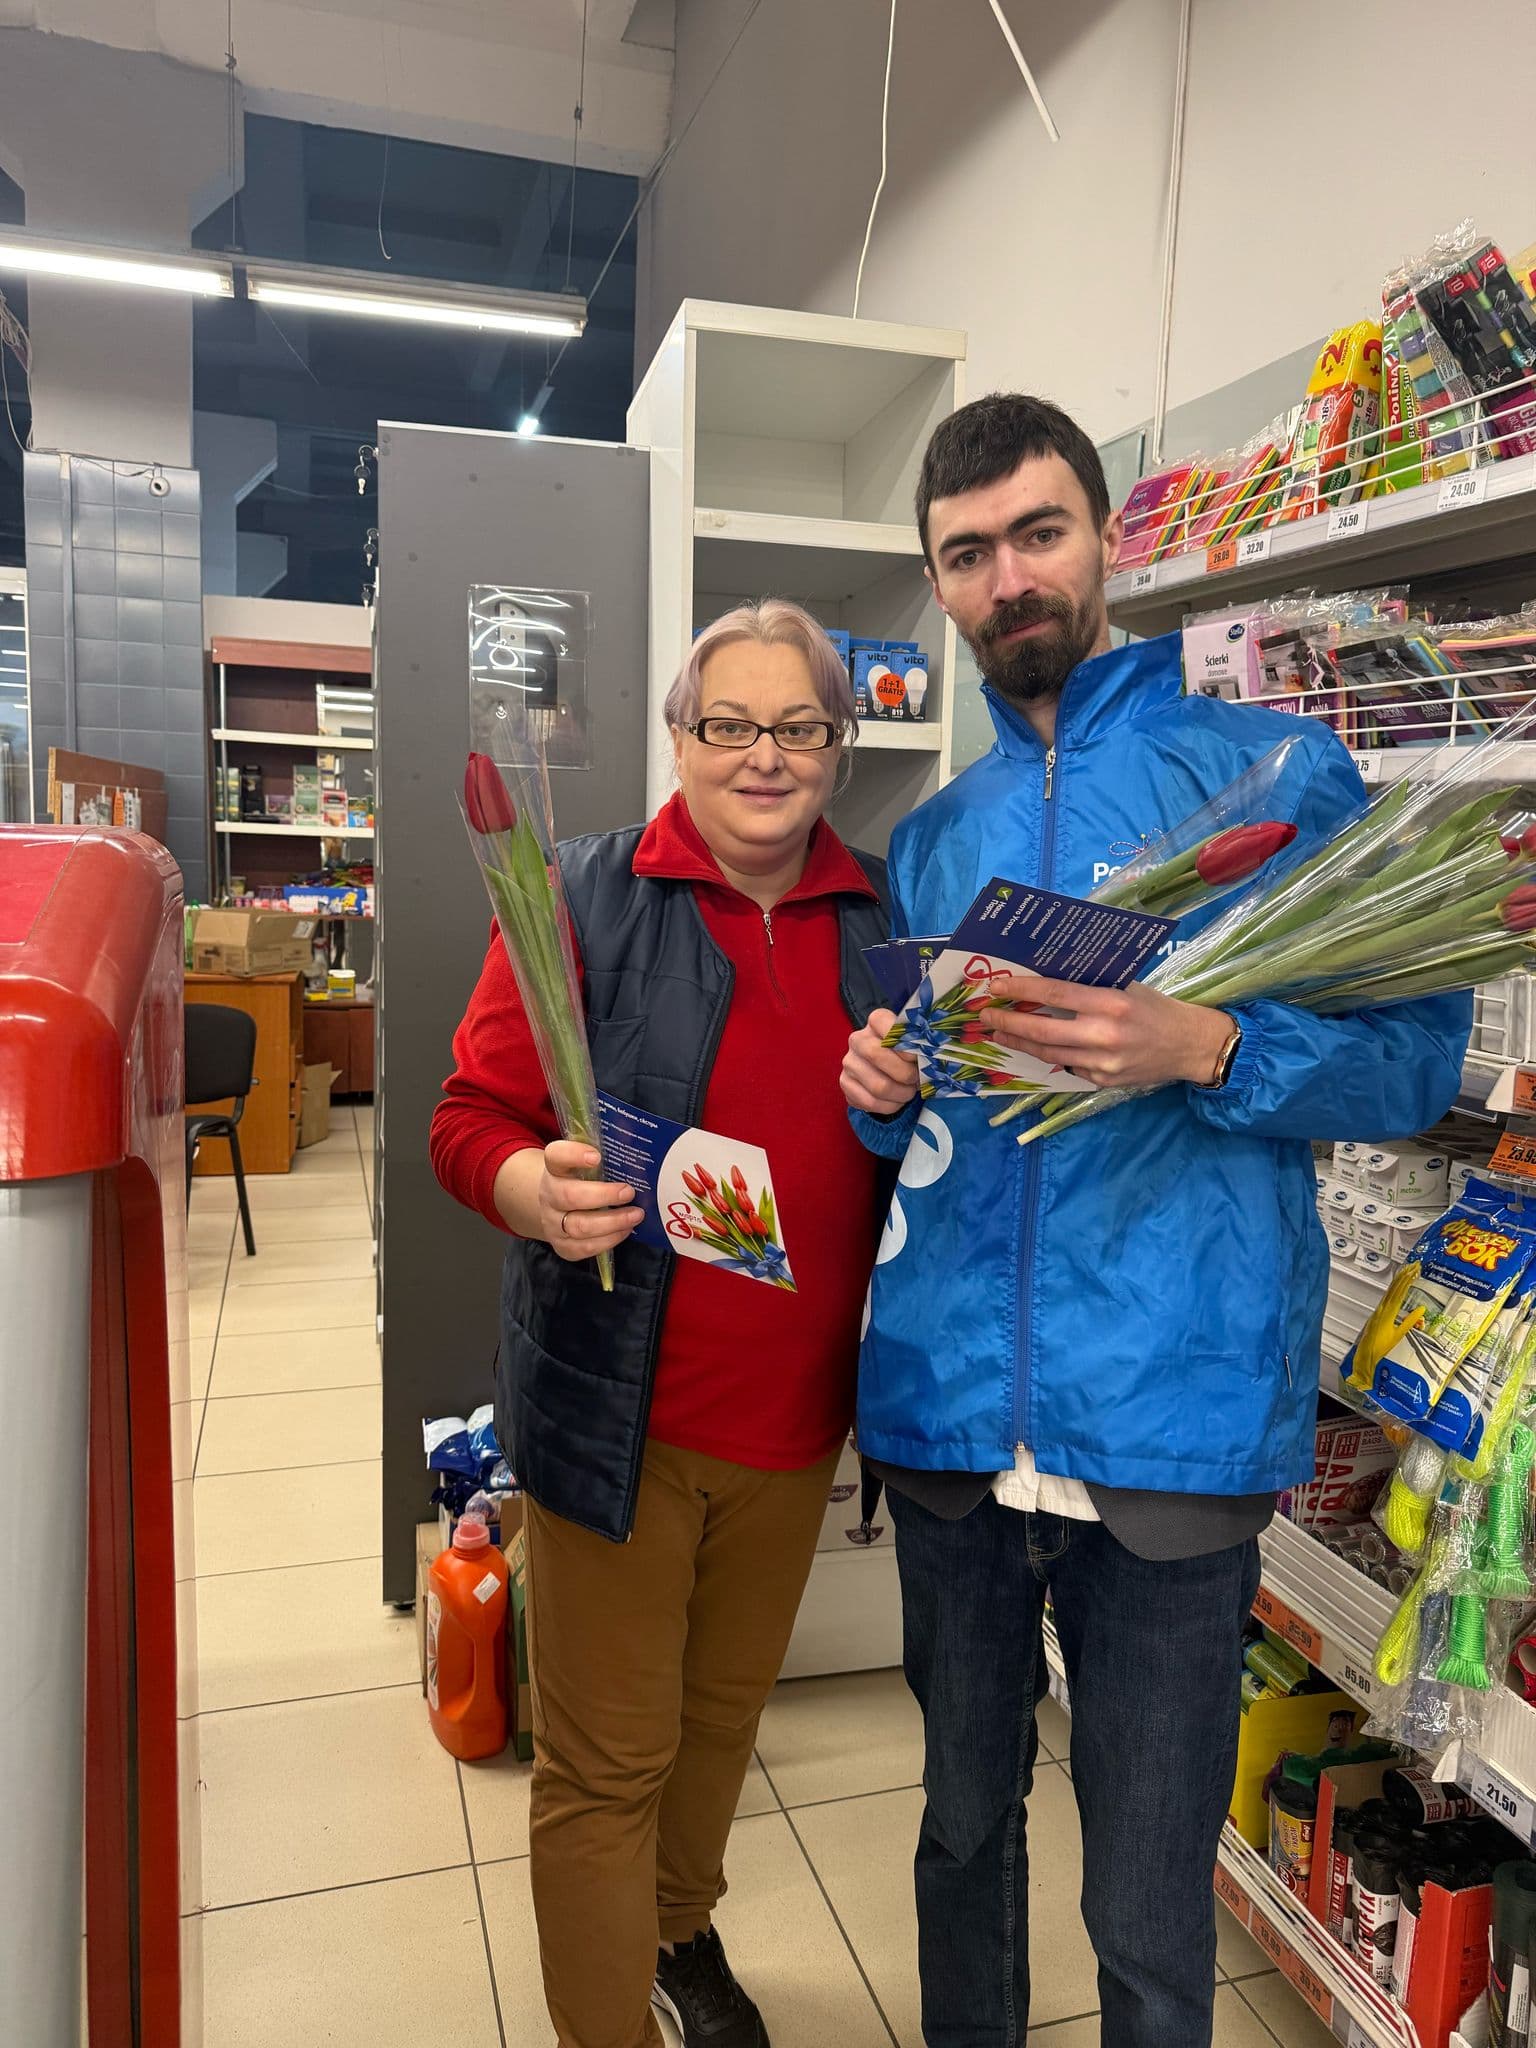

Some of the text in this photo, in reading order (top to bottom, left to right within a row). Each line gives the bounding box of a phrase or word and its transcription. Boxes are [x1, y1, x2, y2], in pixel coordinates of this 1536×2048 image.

[1483, 253, 1497, 269] 10
[1451, 277, 1465, 292] 10
[1162, 482, 1178, 502] 5
[1450, 481, 1476, 498] 24.90
[1338, 513, 1359, 529] 24.50
[867, 653, 889, 662] vito
[903, 656, 925, 665] vito
[1205, 652, 1229, 667] Ścierki
[882, 678, 900, 688] 1+1
[877, 686, 904, 697] GRATIS
[1408, 1171, 1416, 1186] 5
[665, 1202, 693, 1240] 8
[1340, 1435, 1355, 1445] ALU
[1338, 1445, 1355, 1455] FIX
[1344, 1665, 1371, 1695] 85.80
[1486, 1782, 1517, 1818] 21.50
